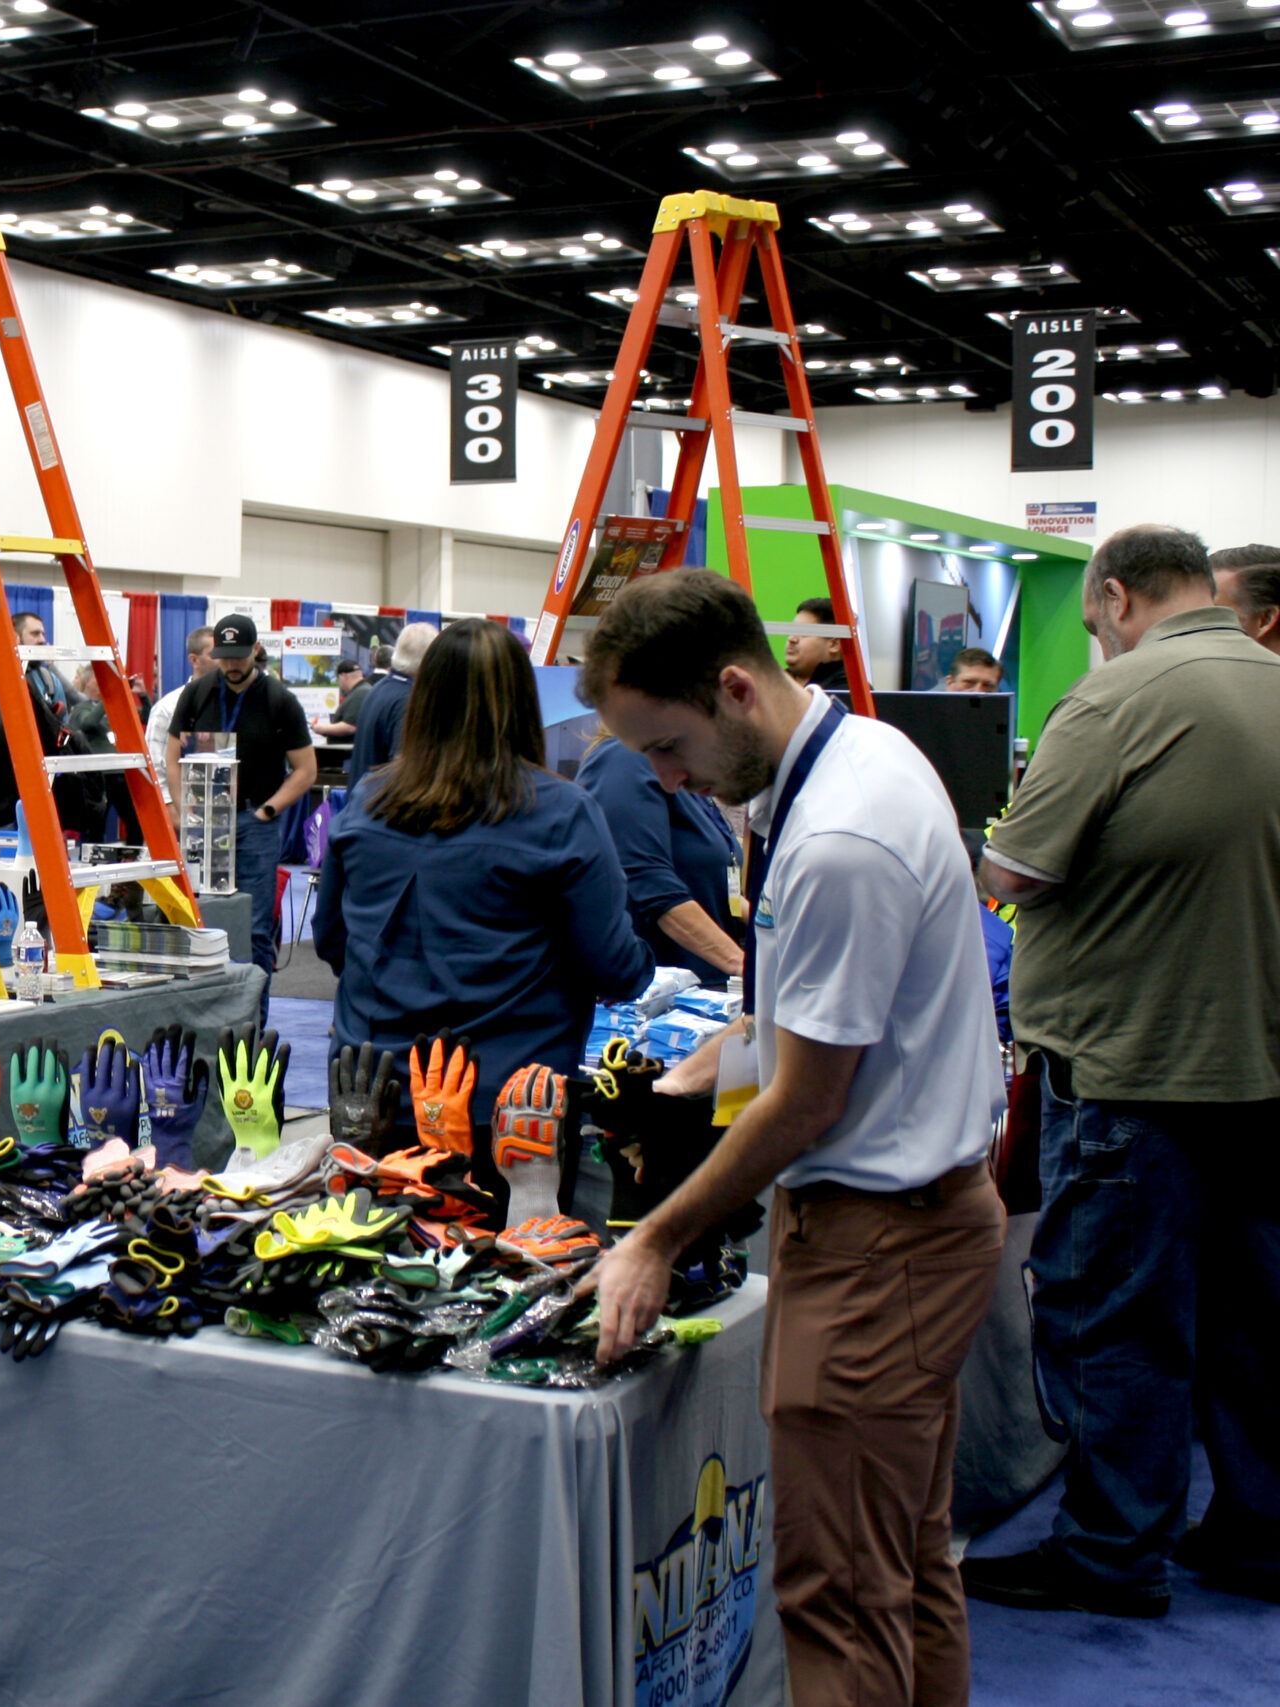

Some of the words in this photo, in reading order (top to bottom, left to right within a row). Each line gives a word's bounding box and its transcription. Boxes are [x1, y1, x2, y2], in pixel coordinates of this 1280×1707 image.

[1026, 318, 1084, 335] AISLE
[461, 347, 508, 362] AISLE
[1029, 348, 1077, 448] 200
[464, 373, 503, 464] 300
[1028, 516, 1094, 526] INNOVATION
[558, 533, 577, 579] WERNER
[296, 636, 339, 648] KERAMIDA
